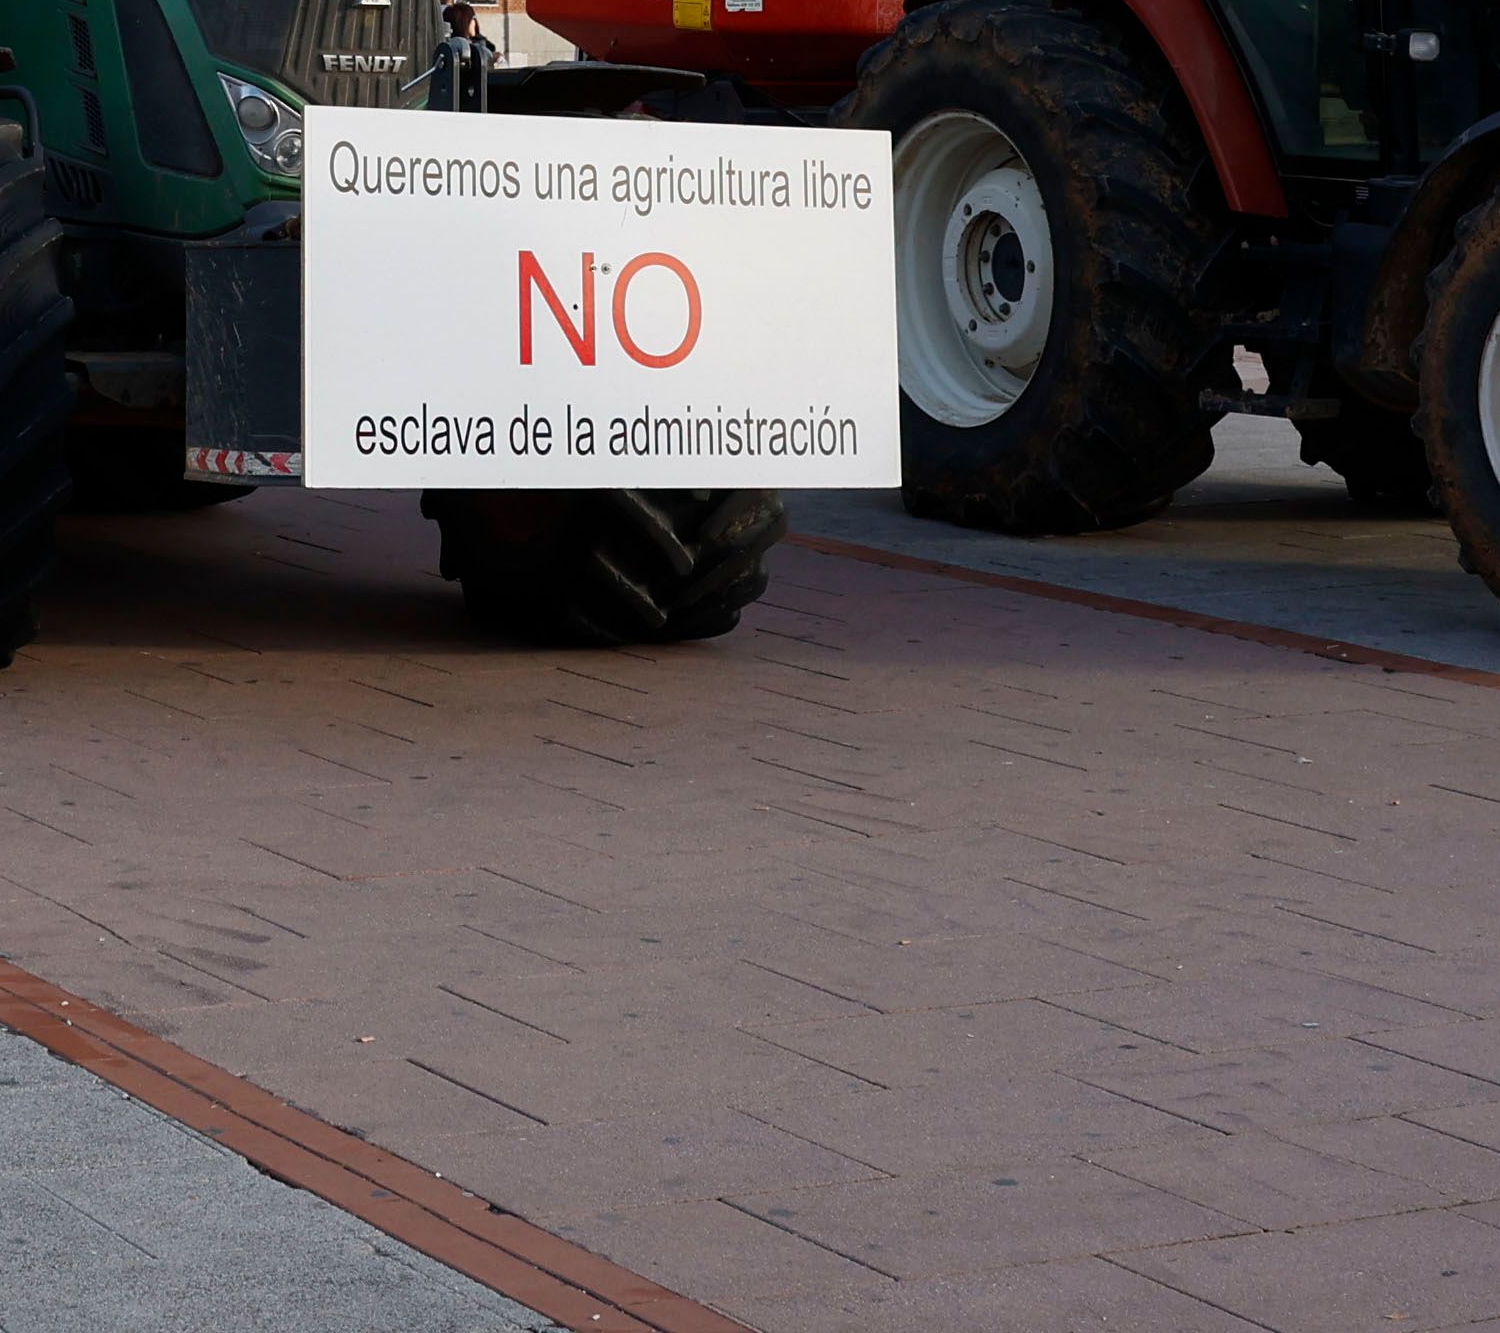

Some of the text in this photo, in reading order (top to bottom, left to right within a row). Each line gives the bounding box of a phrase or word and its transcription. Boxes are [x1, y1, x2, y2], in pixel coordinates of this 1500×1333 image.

[322, 54, 407, 73] FENDT
[329, 140, 873, 216] Queremos una agricultura libre
[518, 250, 702, 369] NO
[355, 403, 858, 457] esclava de la administración
